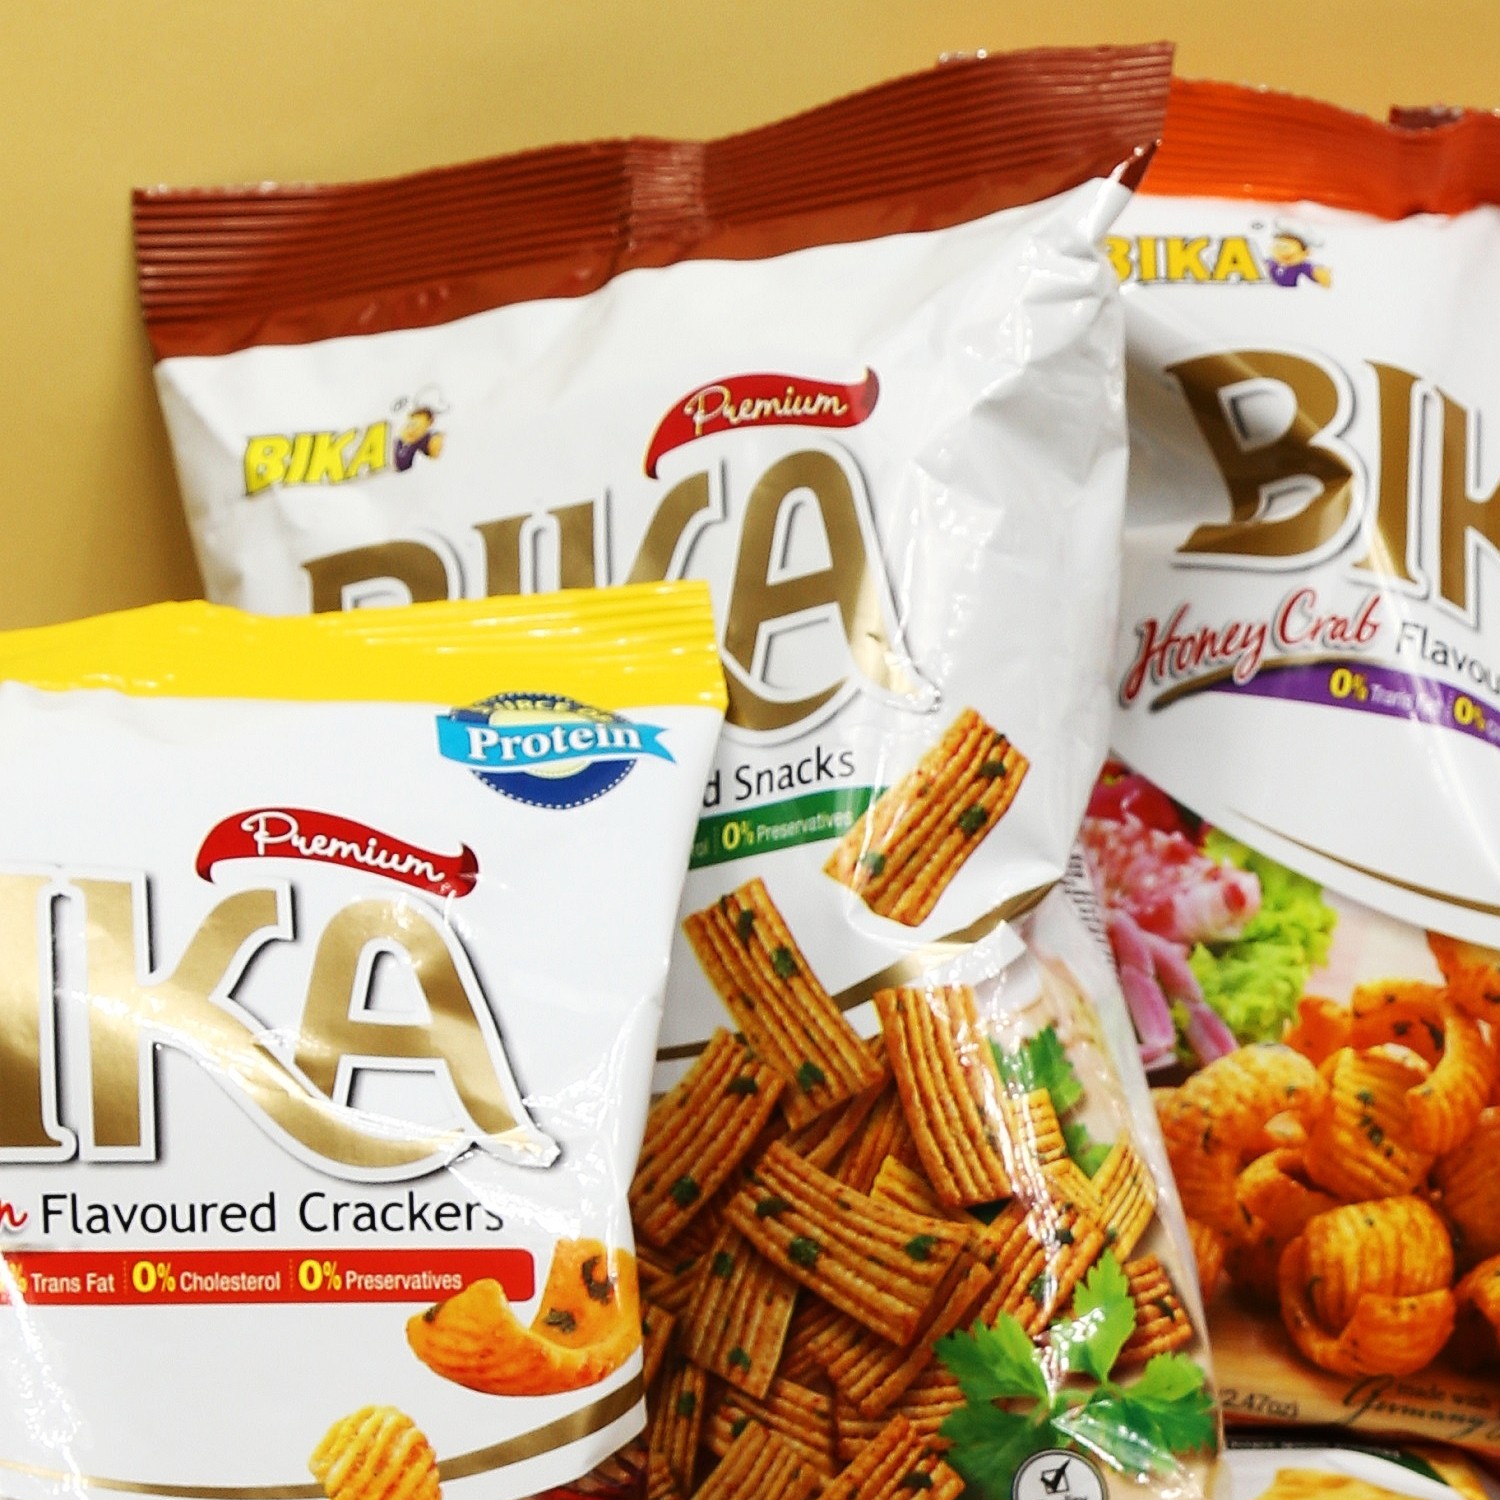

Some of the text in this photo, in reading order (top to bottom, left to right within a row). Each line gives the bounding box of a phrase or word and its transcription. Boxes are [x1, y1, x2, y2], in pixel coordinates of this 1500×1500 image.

[683, 384, 849, 437] Premium
[243, 419, 389, 498] BIKA
[1123, 602, 1269, 701] Honey
[1278, 587, 1383, 646] Crab
[1329, 666, 1369, 702] 0%
[1453, 695, 1487, 732] 0%
[466, 722, 642, 761] Protein
[735, 746, 856, 801] Snacks
[240, 810, 446, 884] Premium
[721, 821, 754, 850] 0%
[0, 868, 562, 1180] IKA
[41, 1190, 277, 1234] Flavoured
[298, 1190, 505, 1233] Crackers
[30, 1272, 81, 1294] Trans
[86, 1272, 115, 1294] Fat
[132, 1260, 176, 1293] 0%
[179, 1271, 282, 1293] Cholesterol
[298, 1258, 342, 1292] 0%
[345, 1270, 463, 1292] Preservatives
